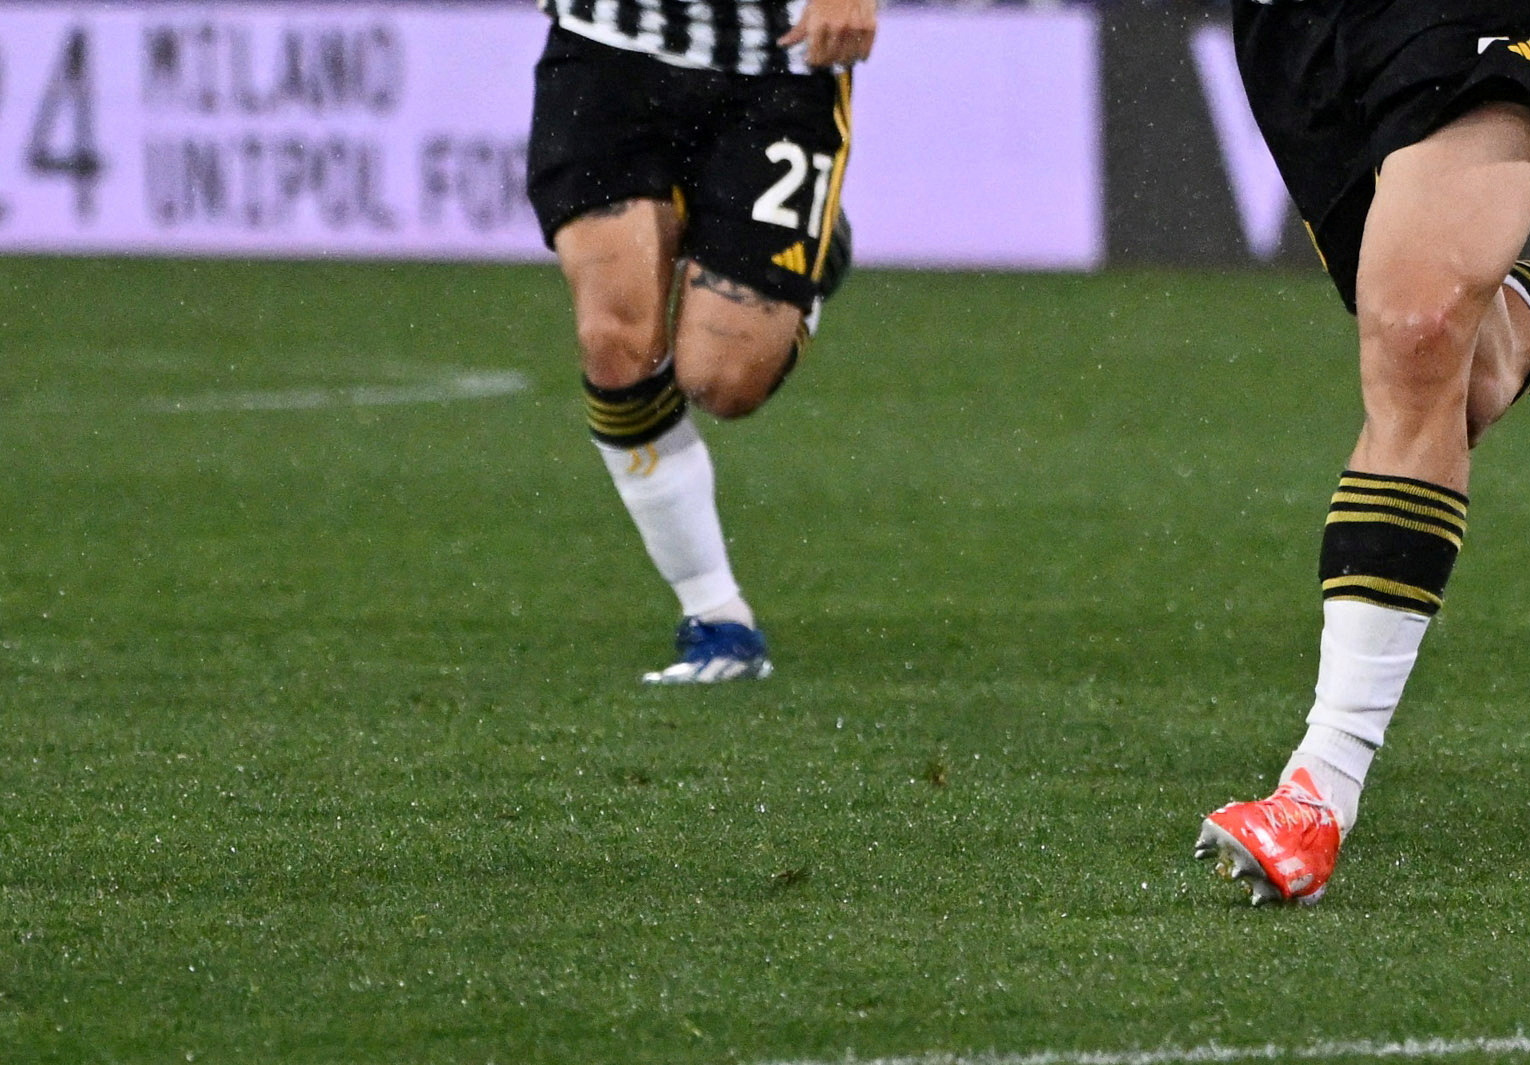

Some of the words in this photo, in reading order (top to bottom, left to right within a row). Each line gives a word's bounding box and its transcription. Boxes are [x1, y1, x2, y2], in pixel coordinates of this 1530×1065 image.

[142, 26, 402, 116] MILANO
[144, 138, 396, 230] UNIPOL
[752, 141, 833, 239] 21
